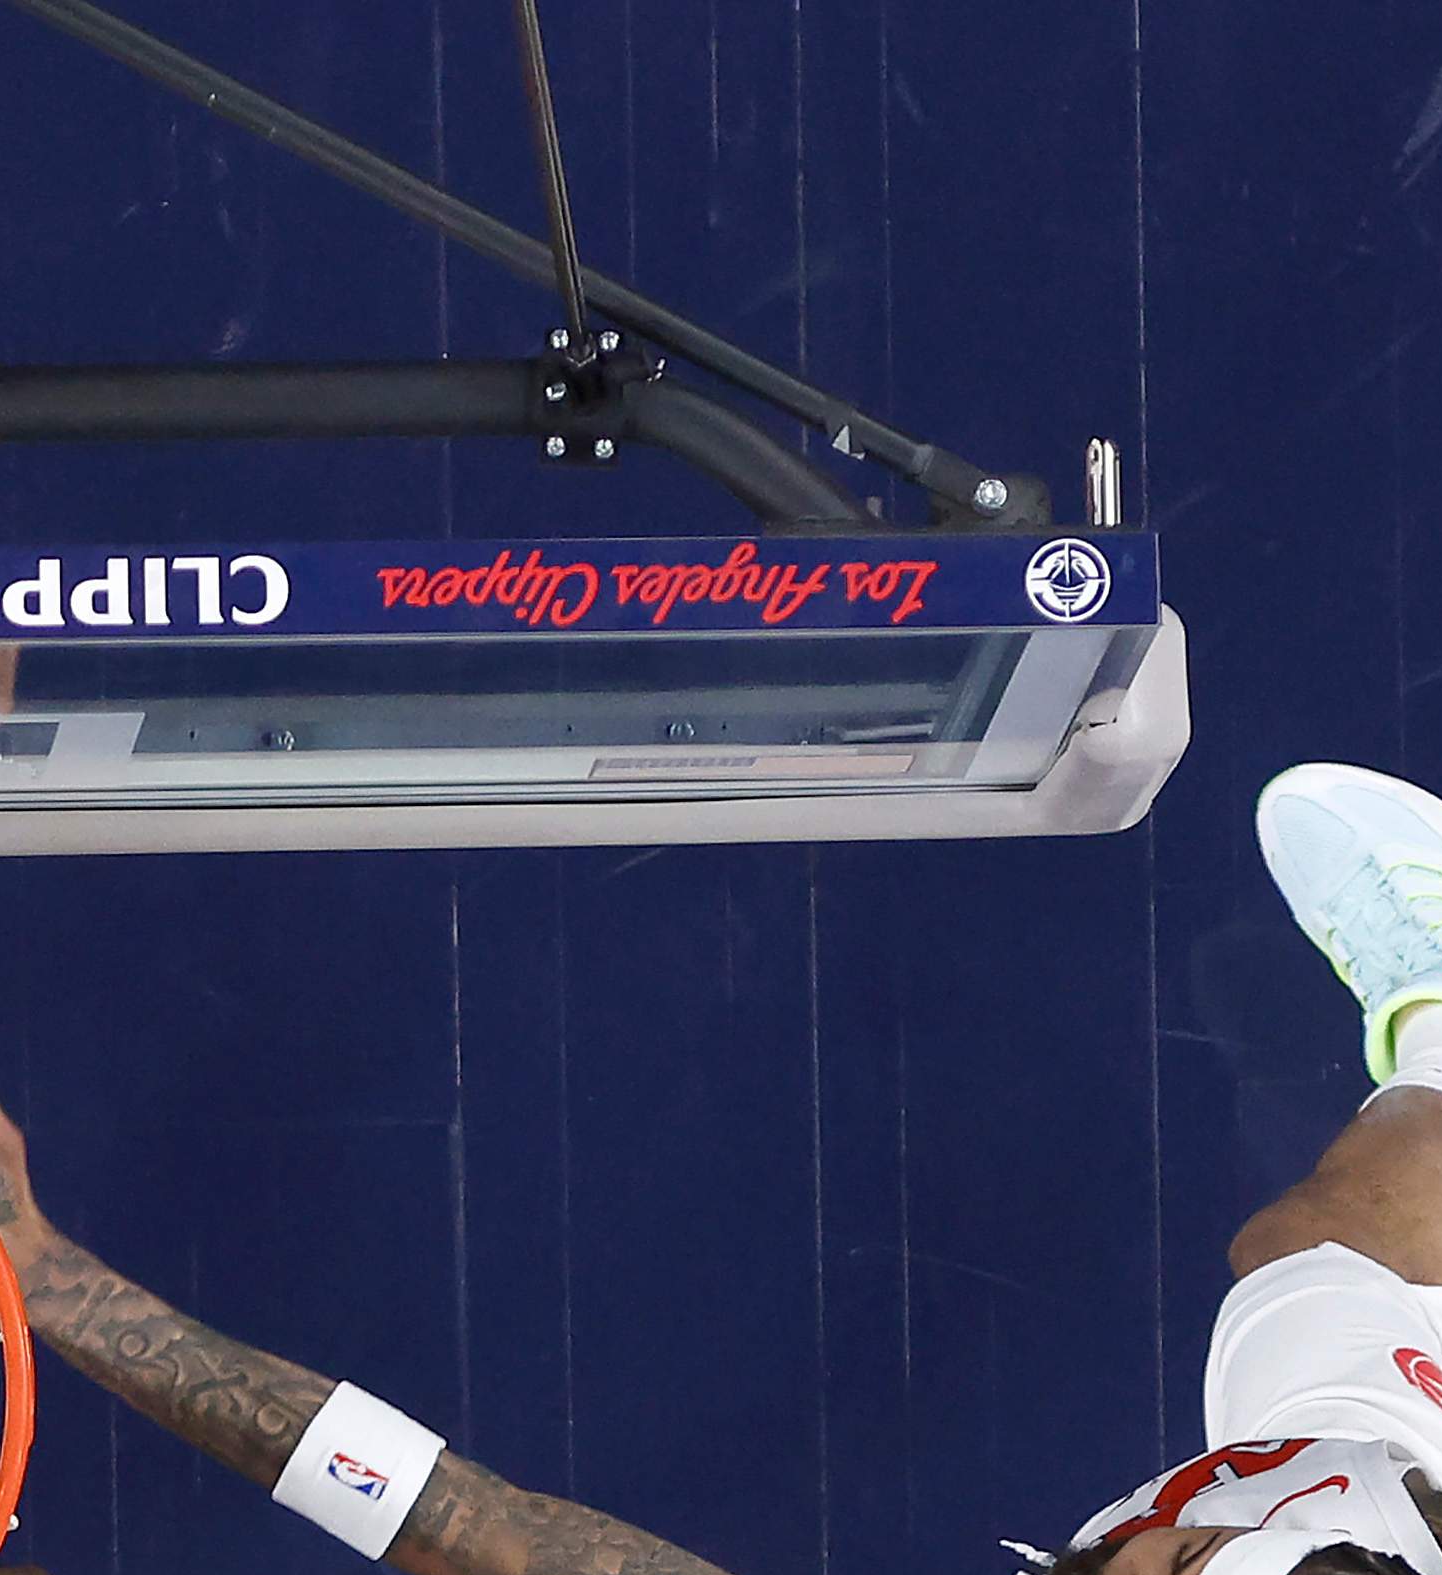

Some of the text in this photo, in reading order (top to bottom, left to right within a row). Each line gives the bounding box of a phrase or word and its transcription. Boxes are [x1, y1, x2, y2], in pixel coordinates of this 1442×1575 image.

[376, 541, 937, 626] Los Angeles Clippers
